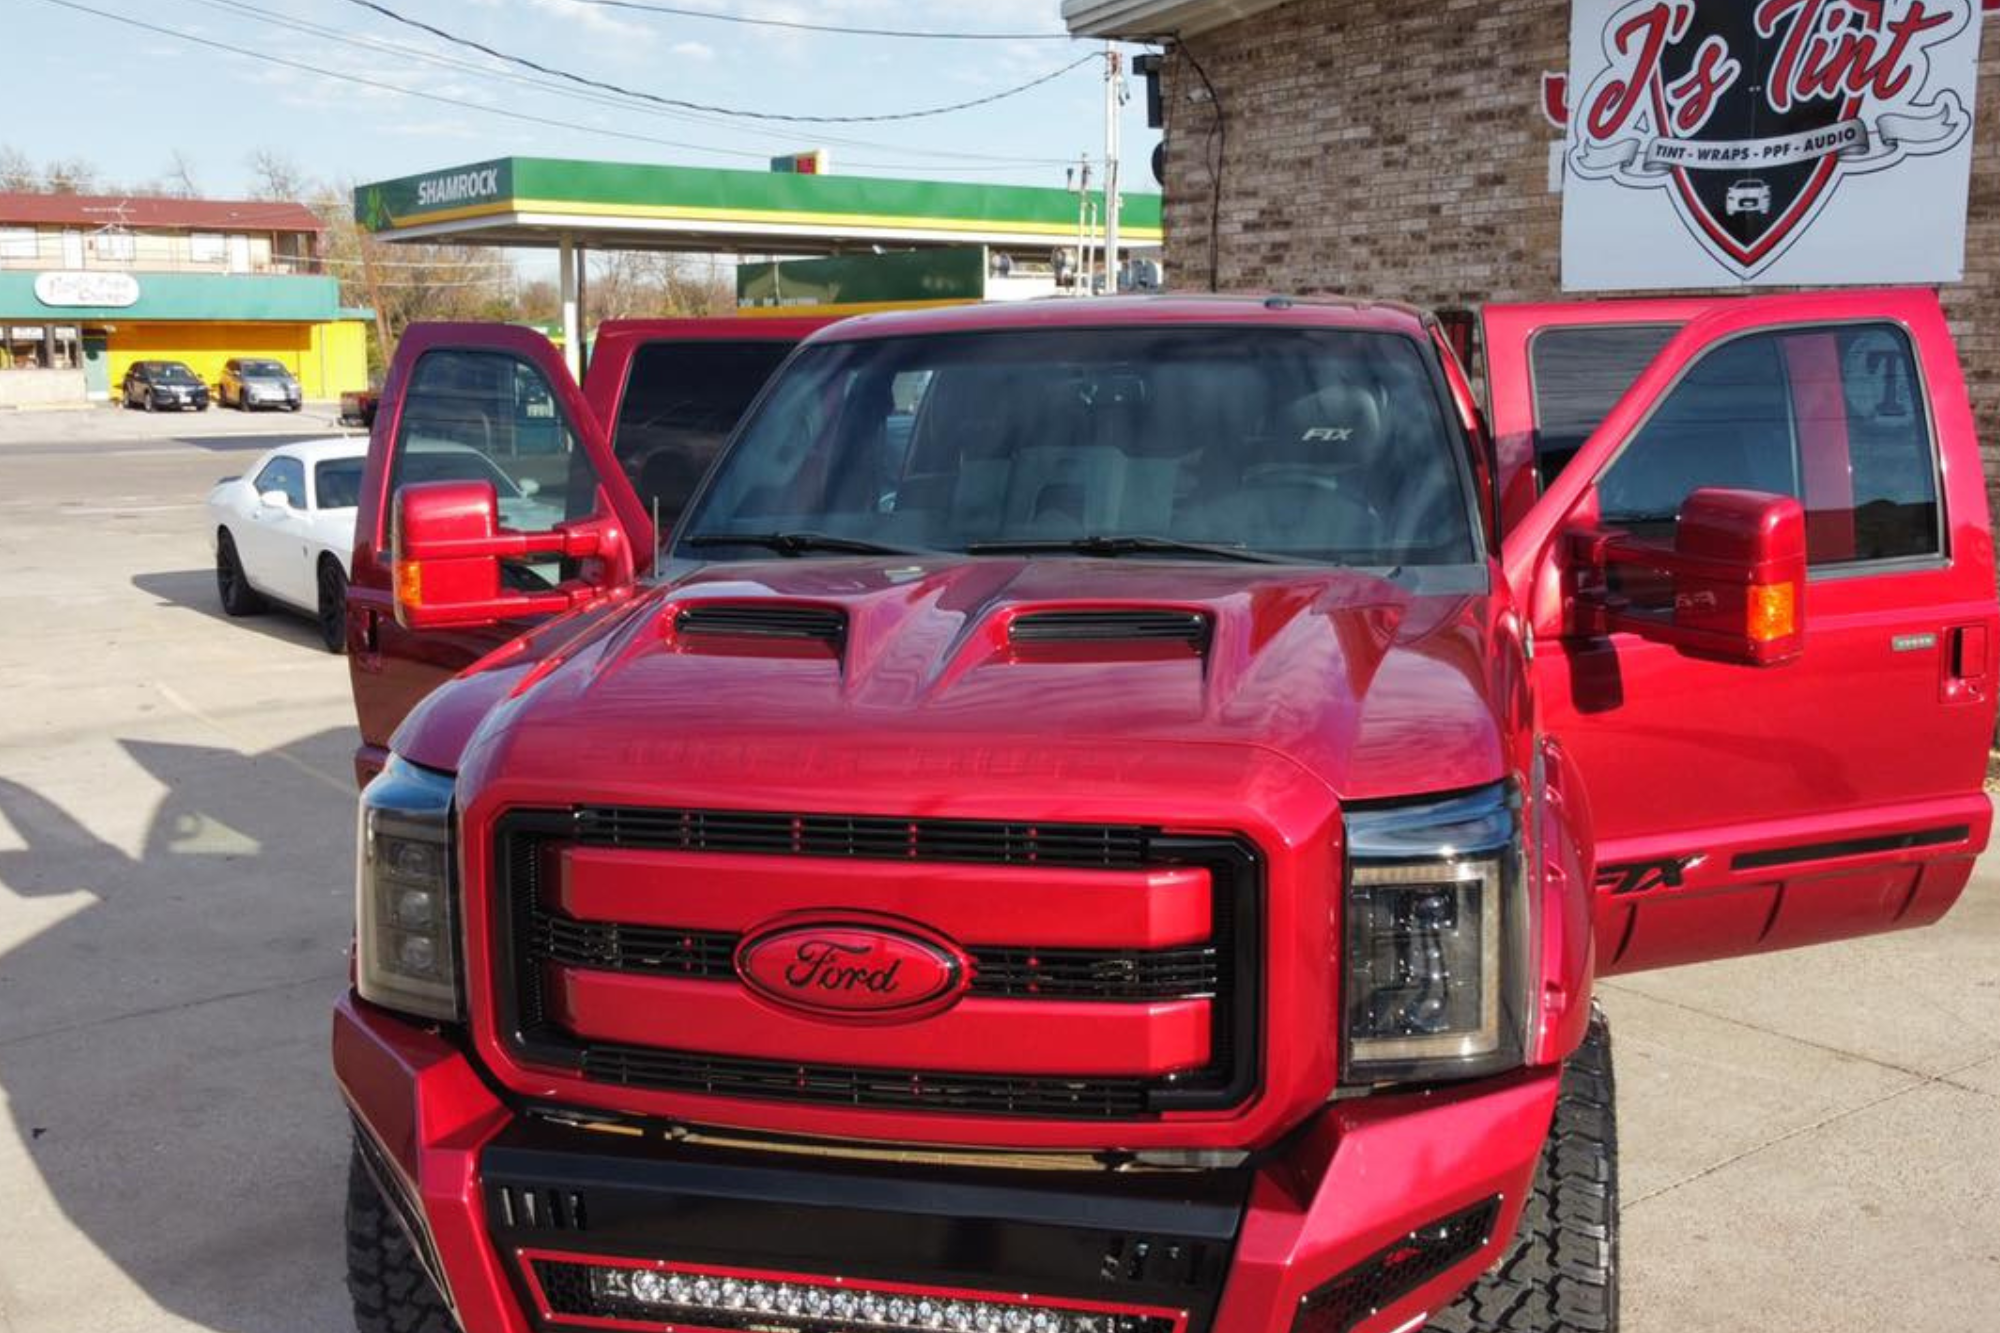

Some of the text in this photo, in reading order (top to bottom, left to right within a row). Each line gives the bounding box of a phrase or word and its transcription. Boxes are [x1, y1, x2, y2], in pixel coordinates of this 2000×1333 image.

[1585, 2, 1736, 140] J's
[1757, 0, 1954, 109] Tint
[1655, 143, 1686, 160] TINT
[1697, 145, 1750, 161] WRAPS
[1762, 143, 1791, 159] PPF
[1803, 127, 1857, 153] AUDIO
[417, 168, 498, 206] SHAMROCK
[784, 938, 903, 993] Ford
